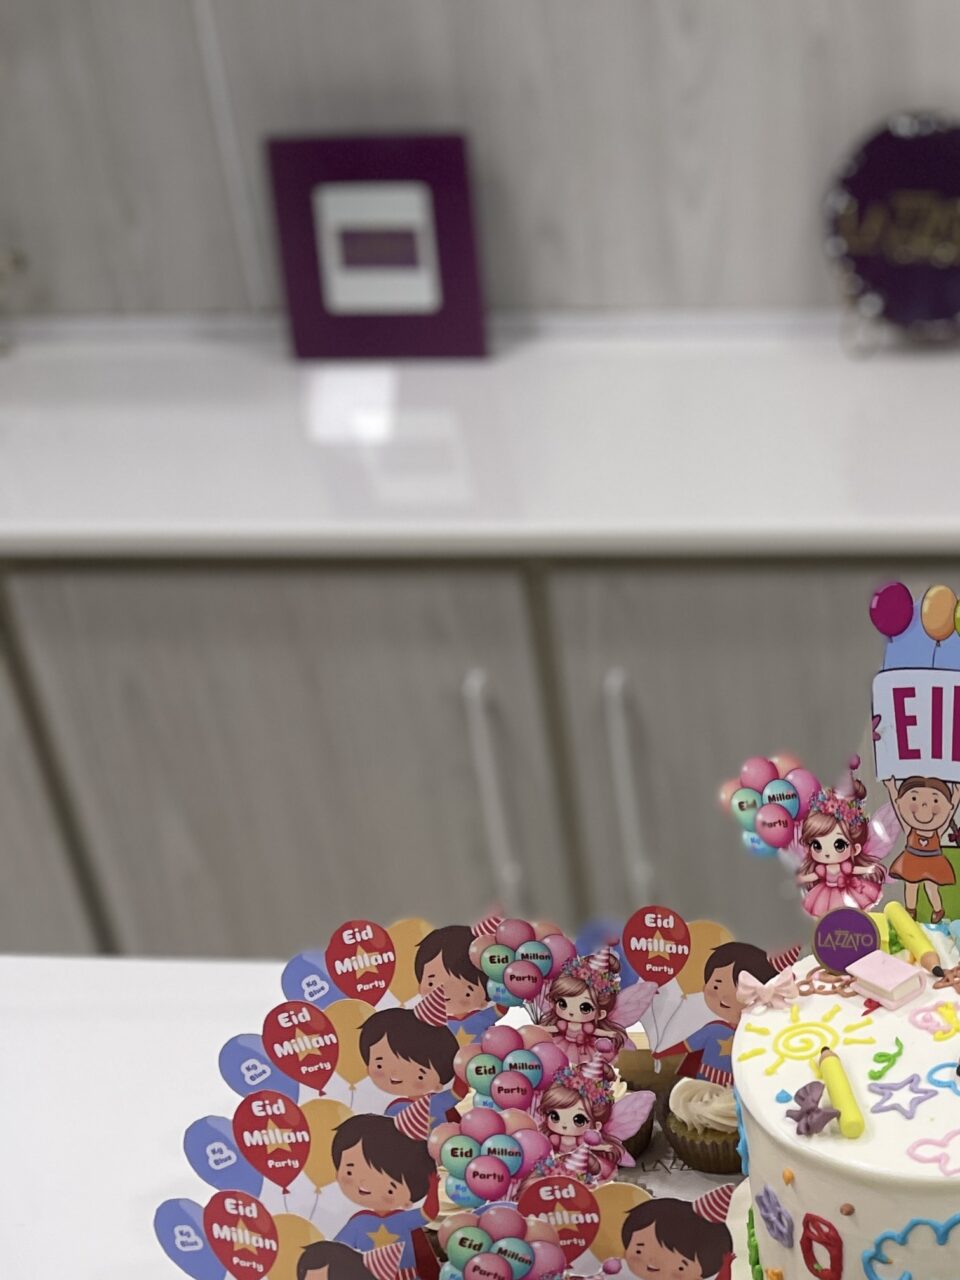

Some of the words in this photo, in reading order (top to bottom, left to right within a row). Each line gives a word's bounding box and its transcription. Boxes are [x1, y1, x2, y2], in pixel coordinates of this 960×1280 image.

[768, 792, 797, 803] Millan
[644, 913, 675, 929] Eid
[342, 924, 374, 945] Eid
[817, 930, 874, 952] LAZZATO
[630, 936, 689, 955] Millan
[334, 951, 395, 975] Millan
[489, 955, 509, 964] Eid
[521, 953, 551, 961] Millan
[645, 963, 674, 975] Party
[356, 979, 386, 992] Party
[509, 974, 538, 984] Party
[277, 1007, 311, 1028] Eid
[273, 1033, 337, 1058] Millan
[300, 1061, 331, 1075] Party
[475, 1066, 496, 1076] Eid
[509, 1063, 541, 1071] Millan
[497, 1086, 527, 1095] Party
[251, 1099, 286, 1117] Eid
[243, 1130, 309, 1147] Millan
[450, 1147, 473, 1158] Eid
[487, 1147, 522, 1157] Millan
[267, 1158, 299, 1169] Party
[472, 1171, 505, 1183] Party
[538, 1183, 576, 1201] Eid
[224, 1198, 258, 1219] Eid
[212, 1223, 277, 1252] Millan
[559, 1238, 586, 1247] arty
[458, 1236, 483, 1252] Eid
[497, 1246, 532, 1266] Millan
[232, 1256, 264, 1273] Party
